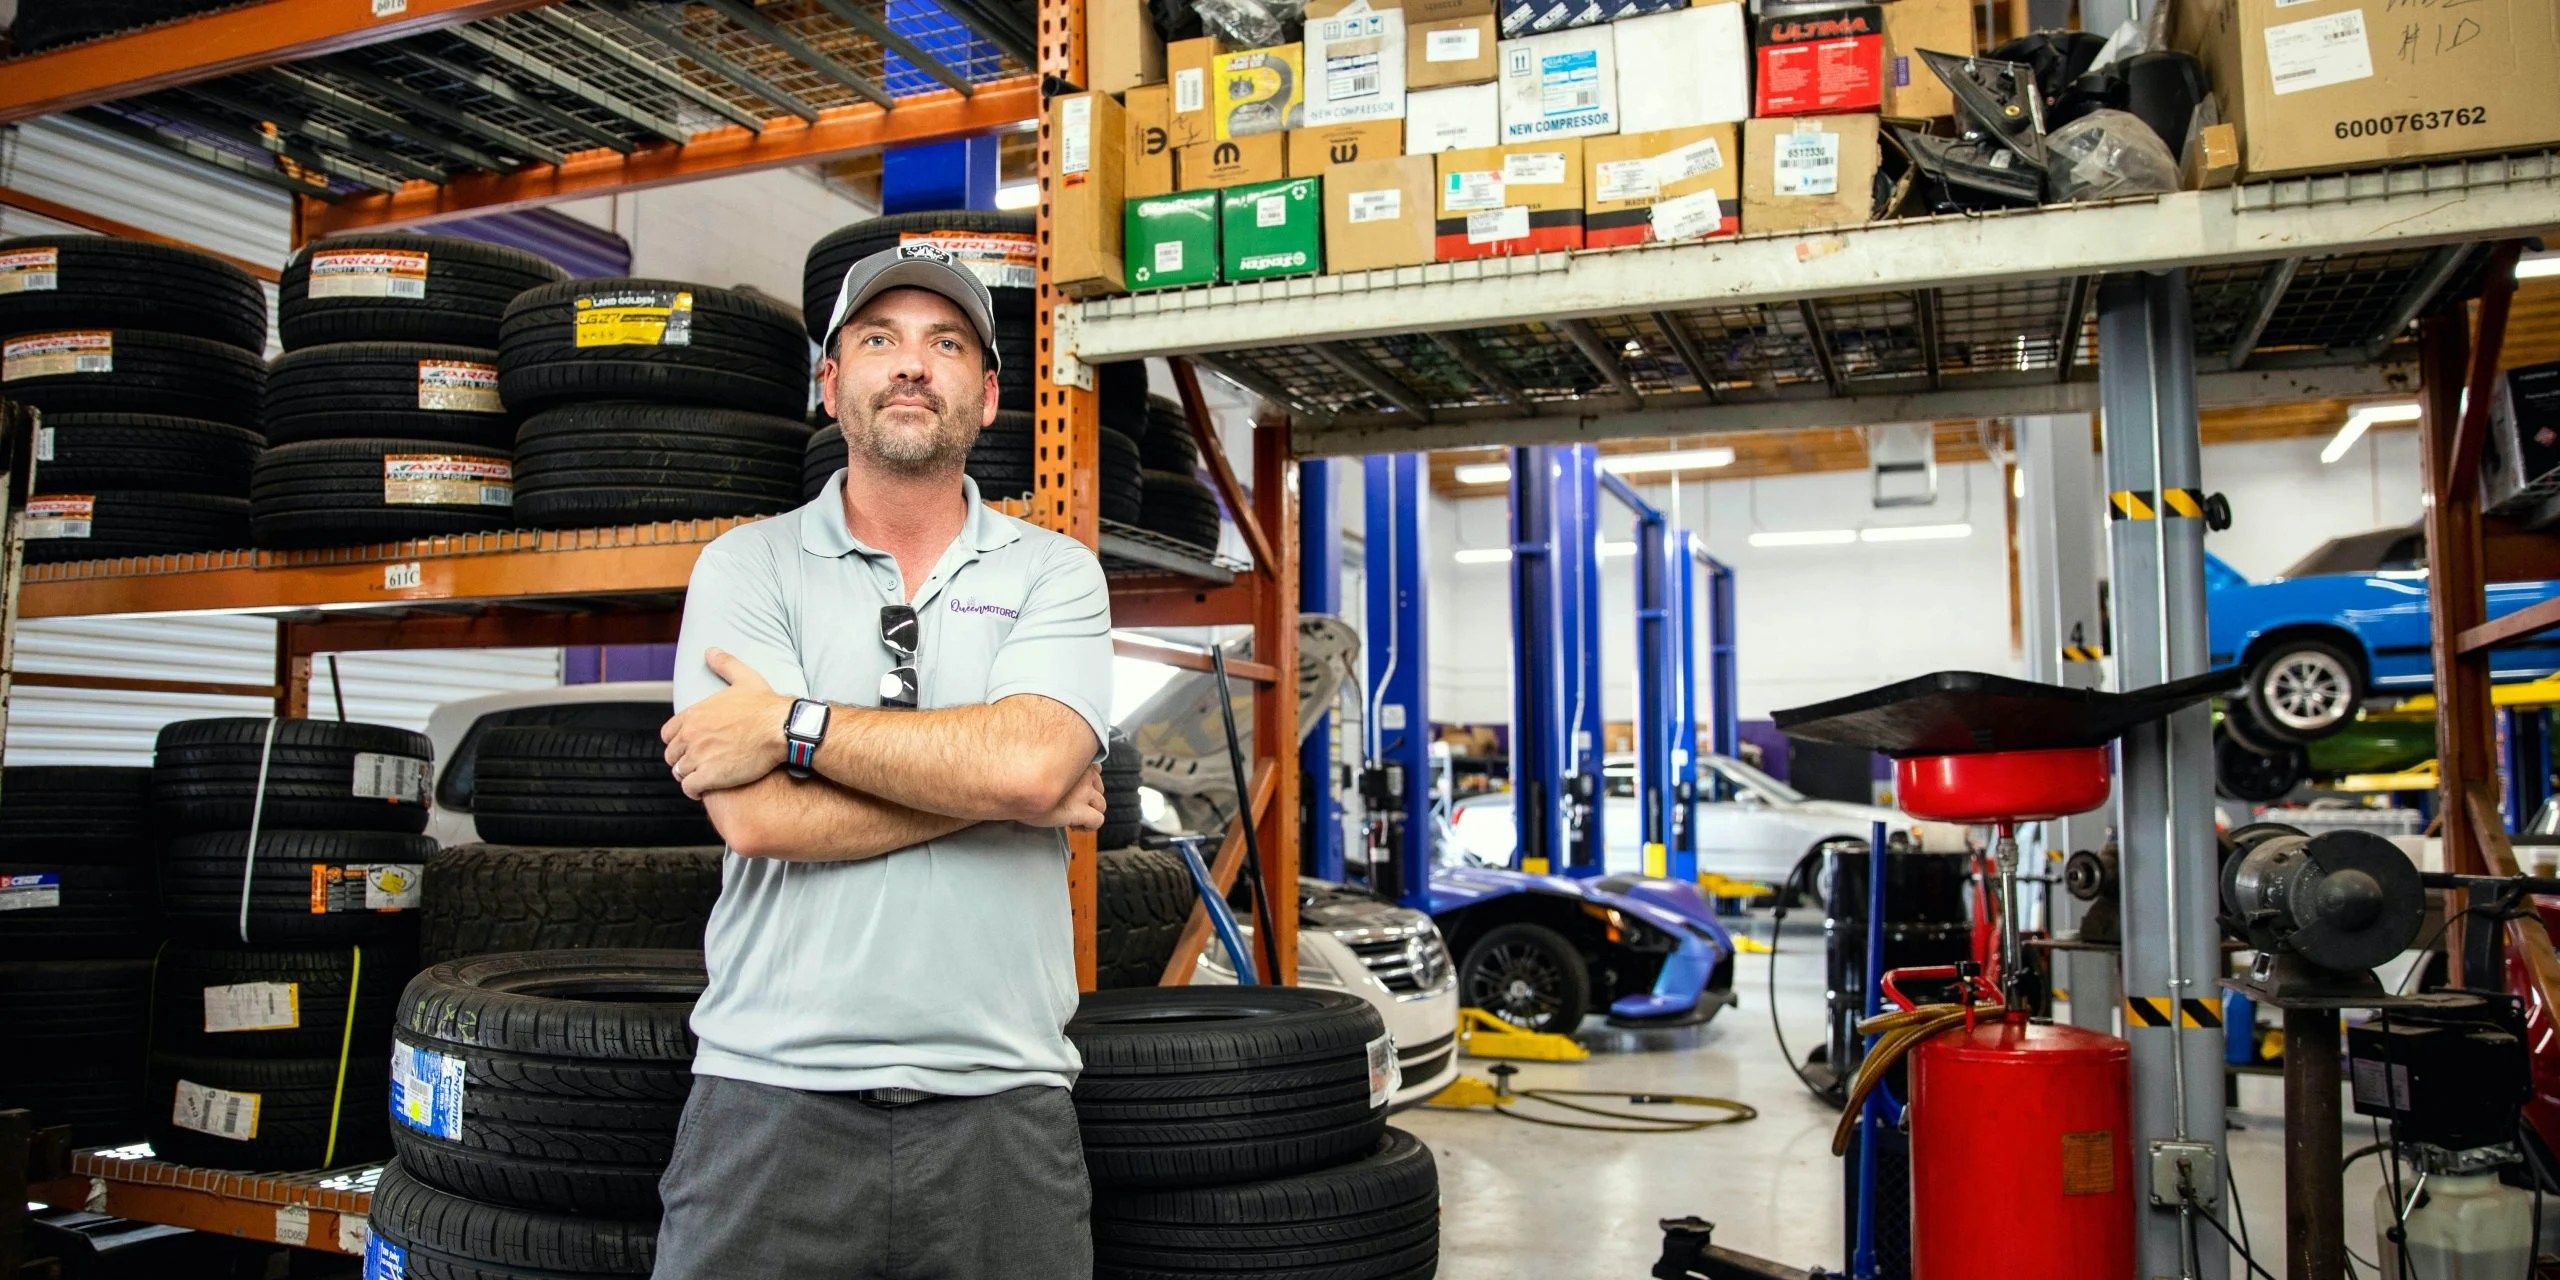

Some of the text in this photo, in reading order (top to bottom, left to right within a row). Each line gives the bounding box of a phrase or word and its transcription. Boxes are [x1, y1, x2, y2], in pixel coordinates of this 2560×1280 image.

[1771, 17, 1870, 41] ULTIMA
[1311, 102, 1394, 120] NEW COMPRESSOR
[1508, 112, 1609, 135] NEW COMPRESSOR
[2335, 106, 2486, 139] 6000763762
[327, 256, 422, 267] ARROYO
[593, 296, 655, 307] LAND GOLDEN
[442, 369, 499, 381] ARR
[409, 463, 508, 475] ARROYO
[389, 571, 418, 587] 611C
[2069, 621, 2084, 648] 4
